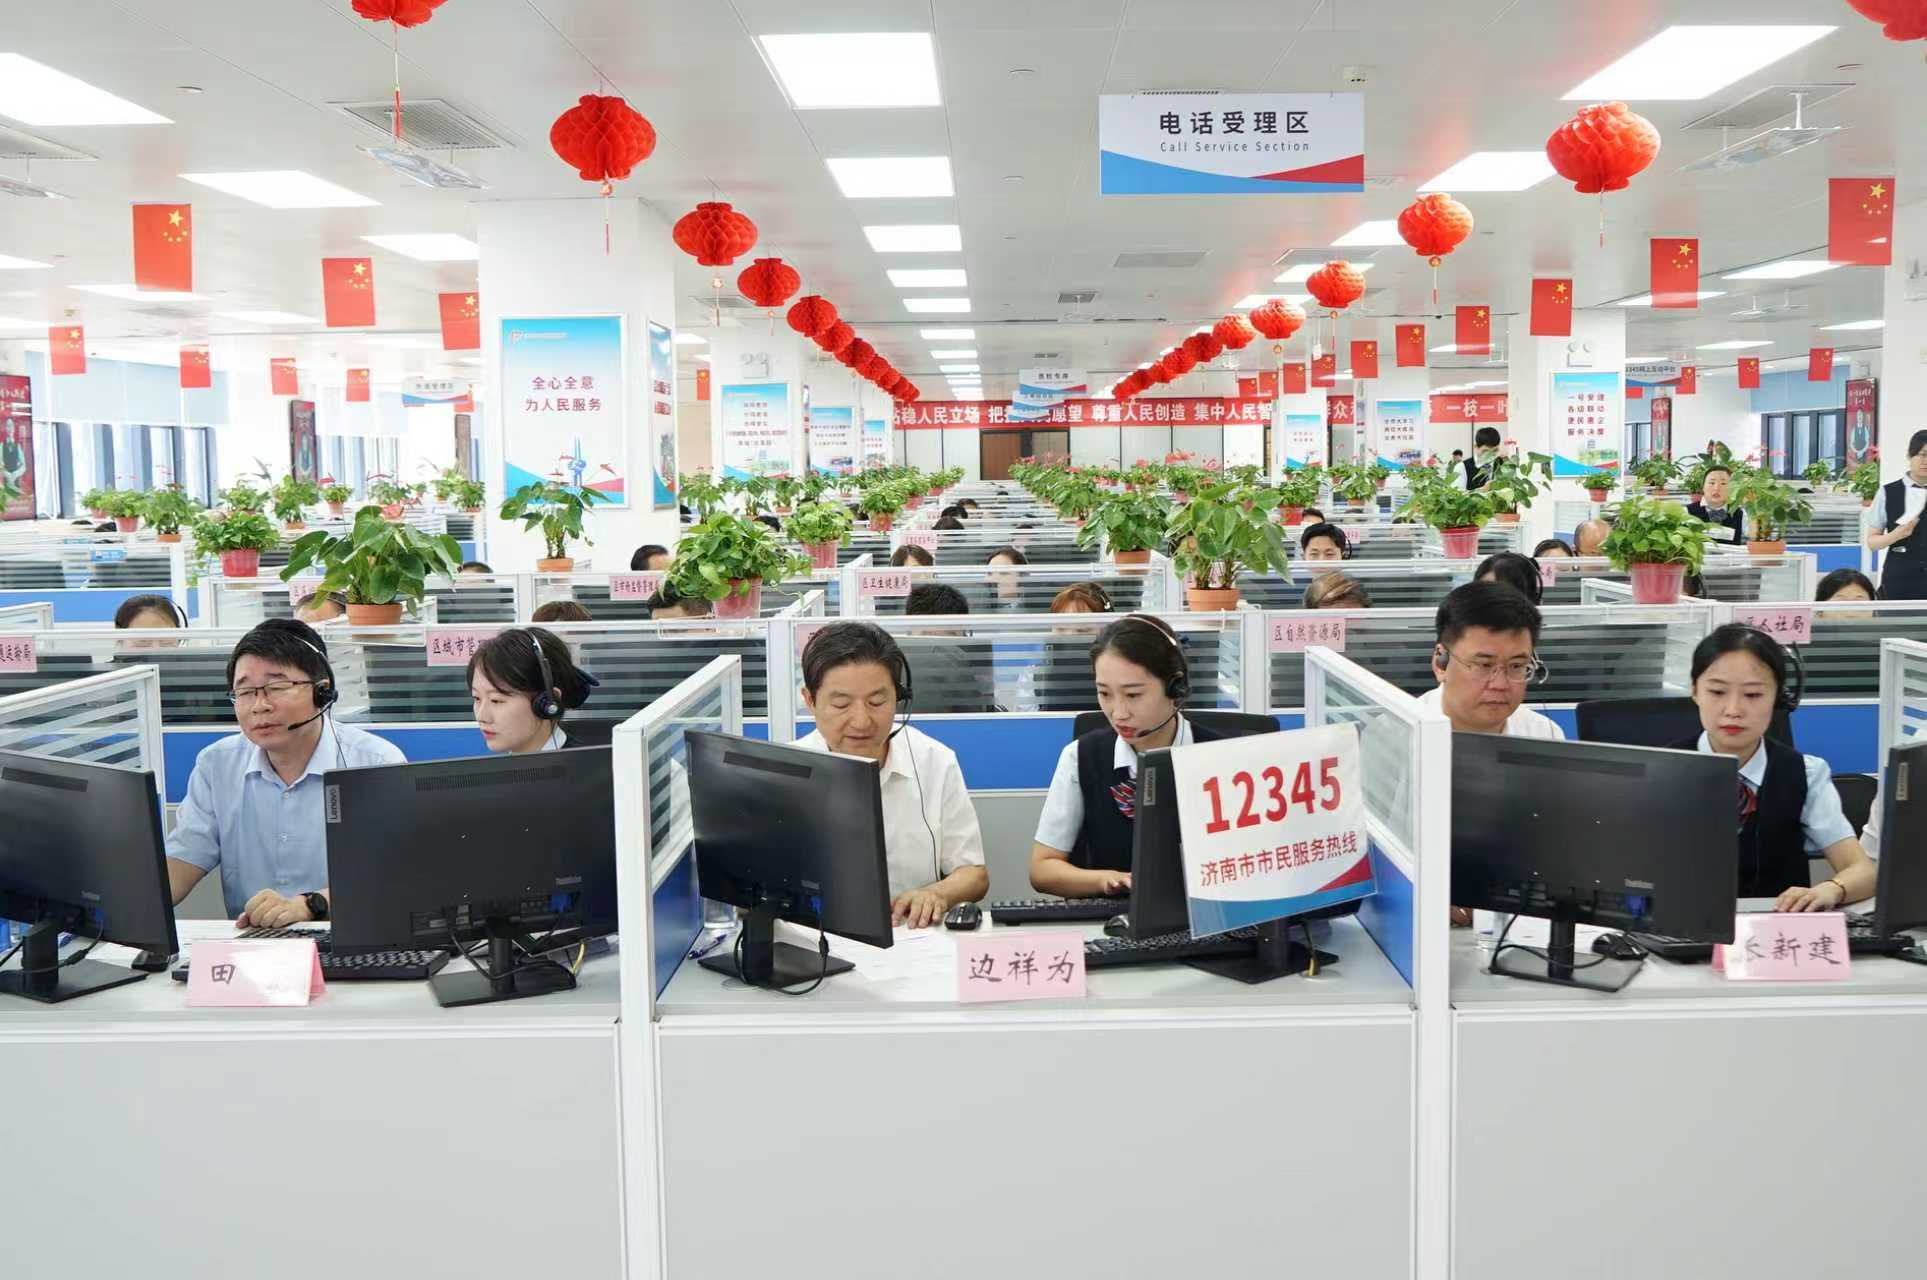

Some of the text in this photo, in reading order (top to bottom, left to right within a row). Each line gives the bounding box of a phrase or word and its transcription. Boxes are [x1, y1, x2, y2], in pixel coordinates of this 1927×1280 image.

[1160, 111, 1309, 135] 电话受理区
[1160, 141, 1310, 152] Call Service Section
[532, 376, 594, 390] 全心全意
[525, 398, 601, 412] 为人民服务
[988, 405, 1083, 423] 把愿望
[1092, 402, 1186, 422] 尊重人民创造
[863, 575, 909, 590] 区卫生健康局
[1274, 623, 1341, 642] 区自然资源局
[433, 636, 483, 657] 区城市管
[327, 788, 338, 820] Lenovo
[1203, 757, 1341, 834] 12345
[1201, 831, 1357, 887] 济南市市民服务热线
[968, 950, 1075, 986] 边祥为
